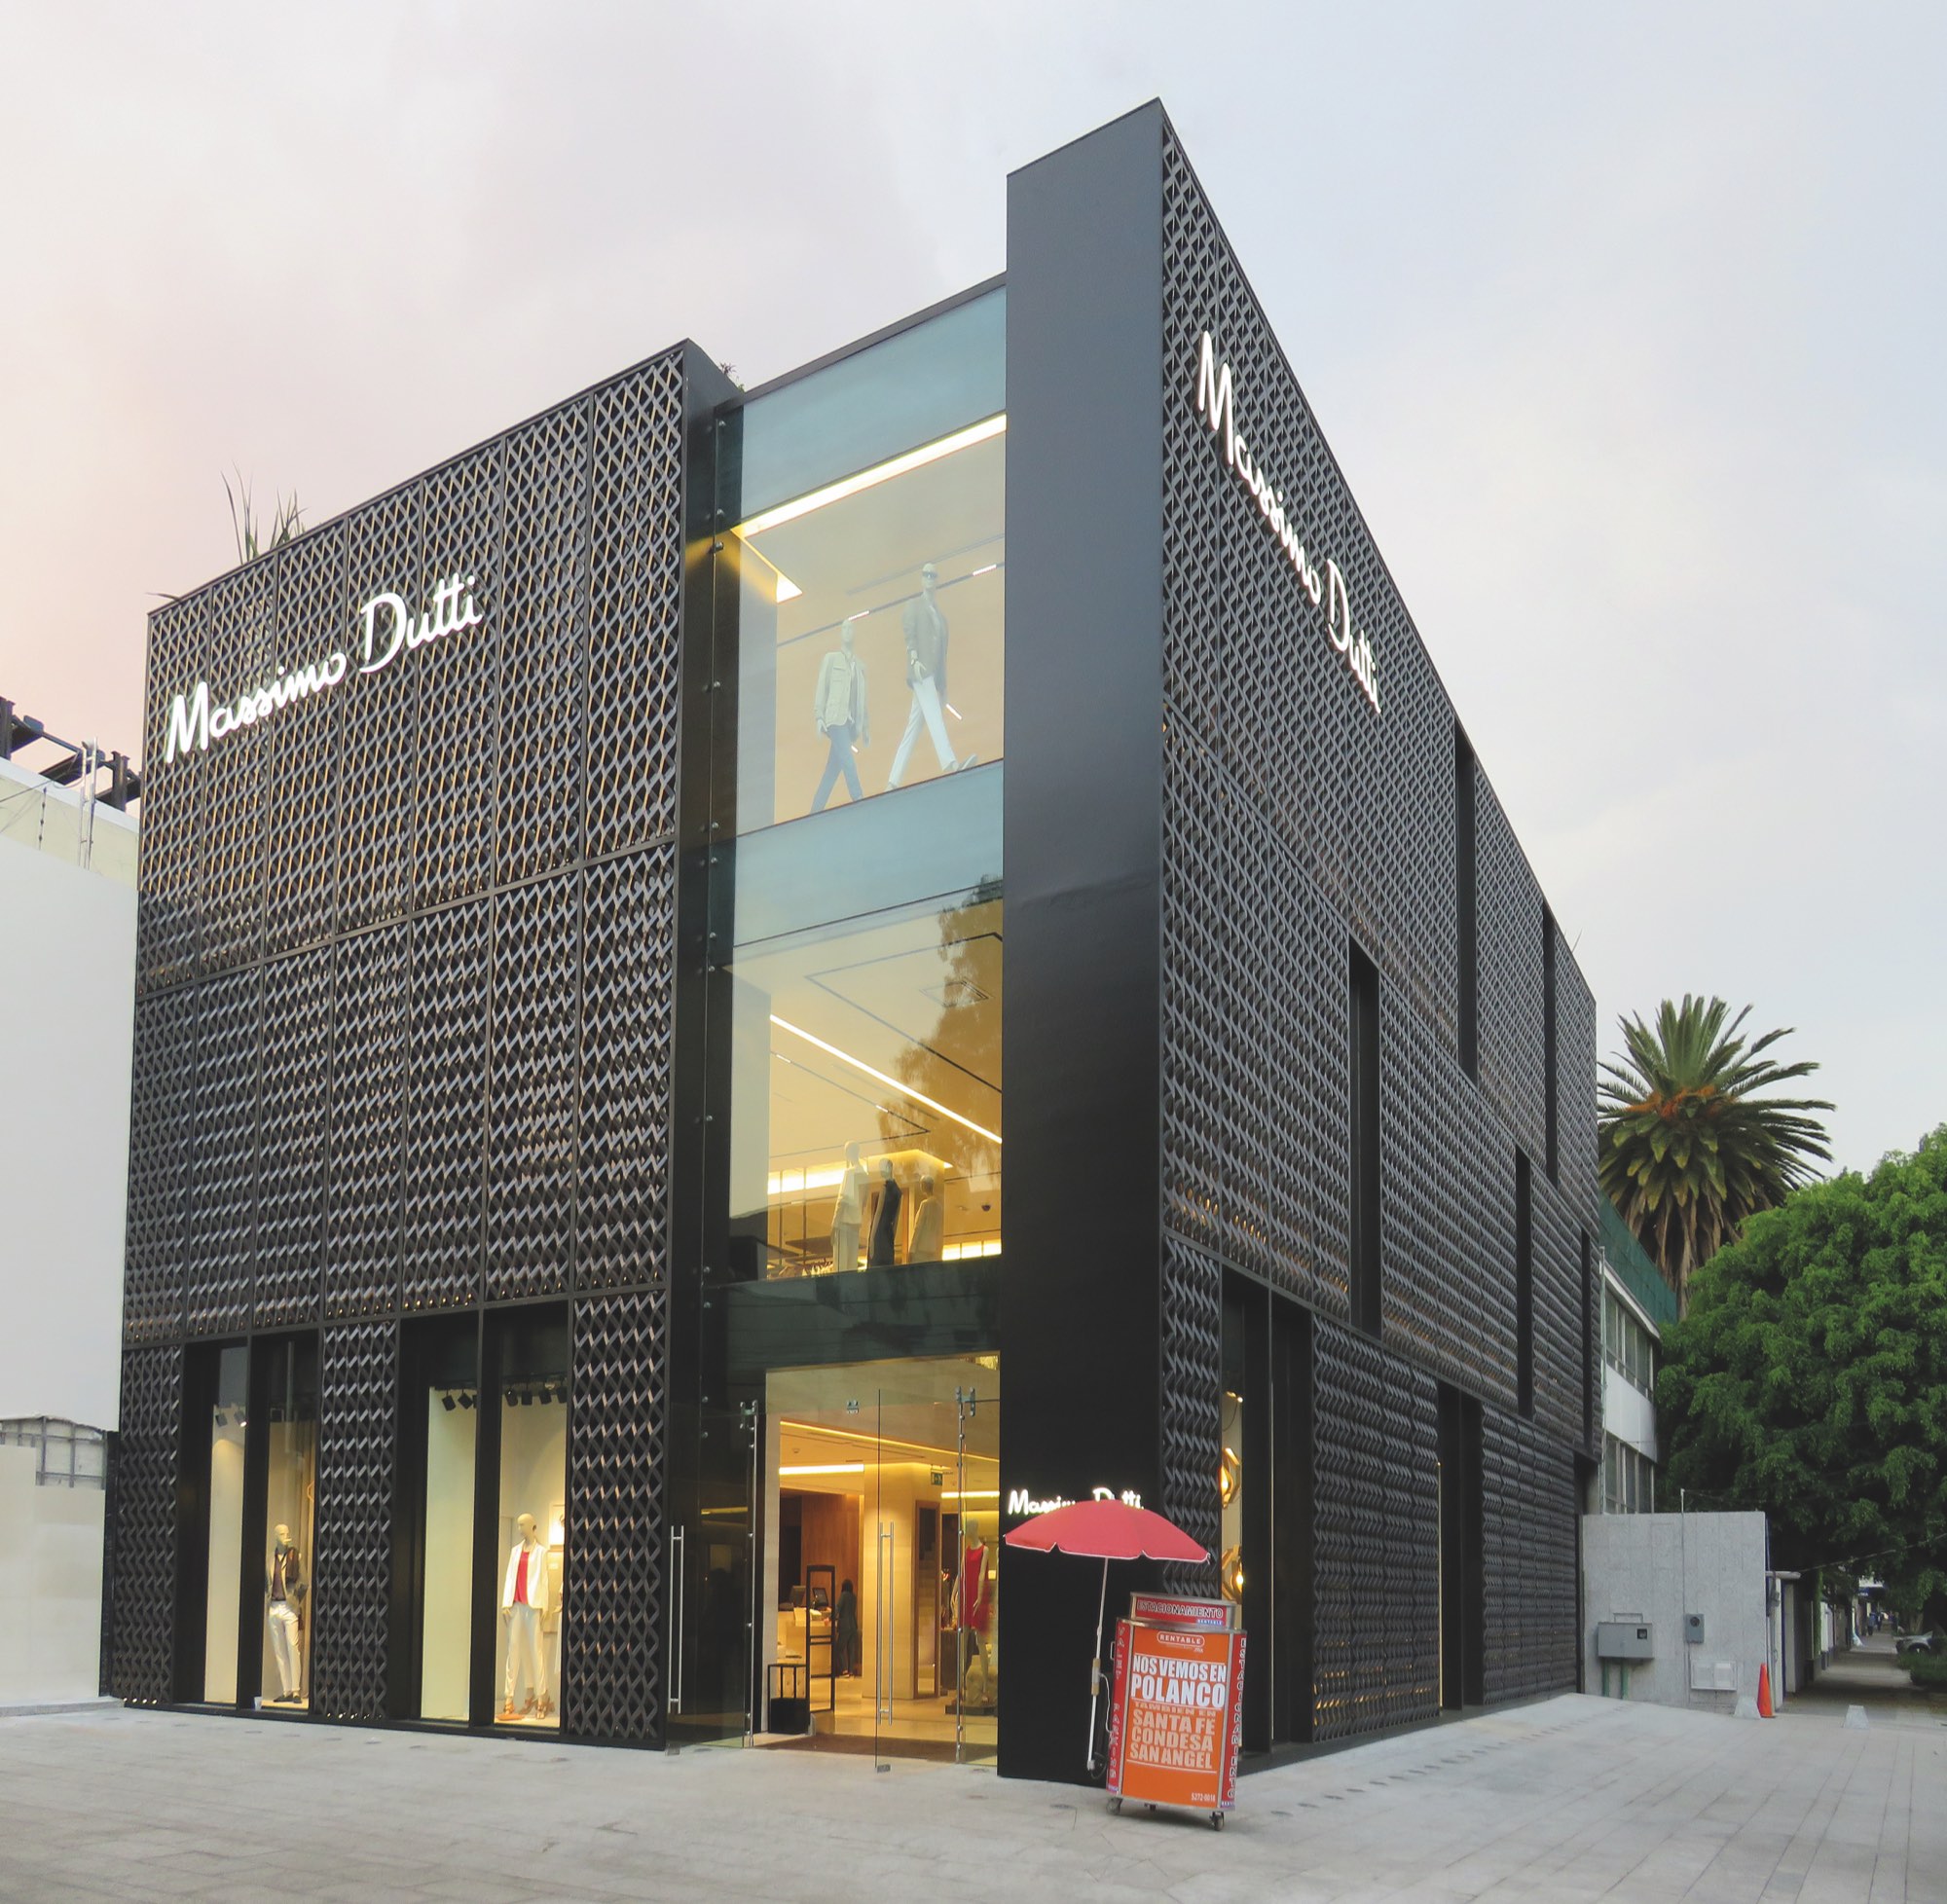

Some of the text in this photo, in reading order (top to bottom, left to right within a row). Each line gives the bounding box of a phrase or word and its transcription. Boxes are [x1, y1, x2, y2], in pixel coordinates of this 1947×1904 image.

[1197, 330, 1381, 714] Massimo Dutti
[166, 572, 484, 763] Massimo Dutti
[1136, 1599, 1224, 1619] ESTACIONAMIENTO
[1159, 1633, 1202, 1645] RENTABLE
[1132, 1655, 1227, 1682] NOS VEMOS EN
[1130, 1673, 1226, 1708] POLANCO
[1132, 1708, 1193, 1733] SANTA
[1198, 1708, 1216, 1717] EN
[1131, 1726, 1214, 1752] CONDESA
[1129, 1742, 1213, 1769] SAN ANGEL
